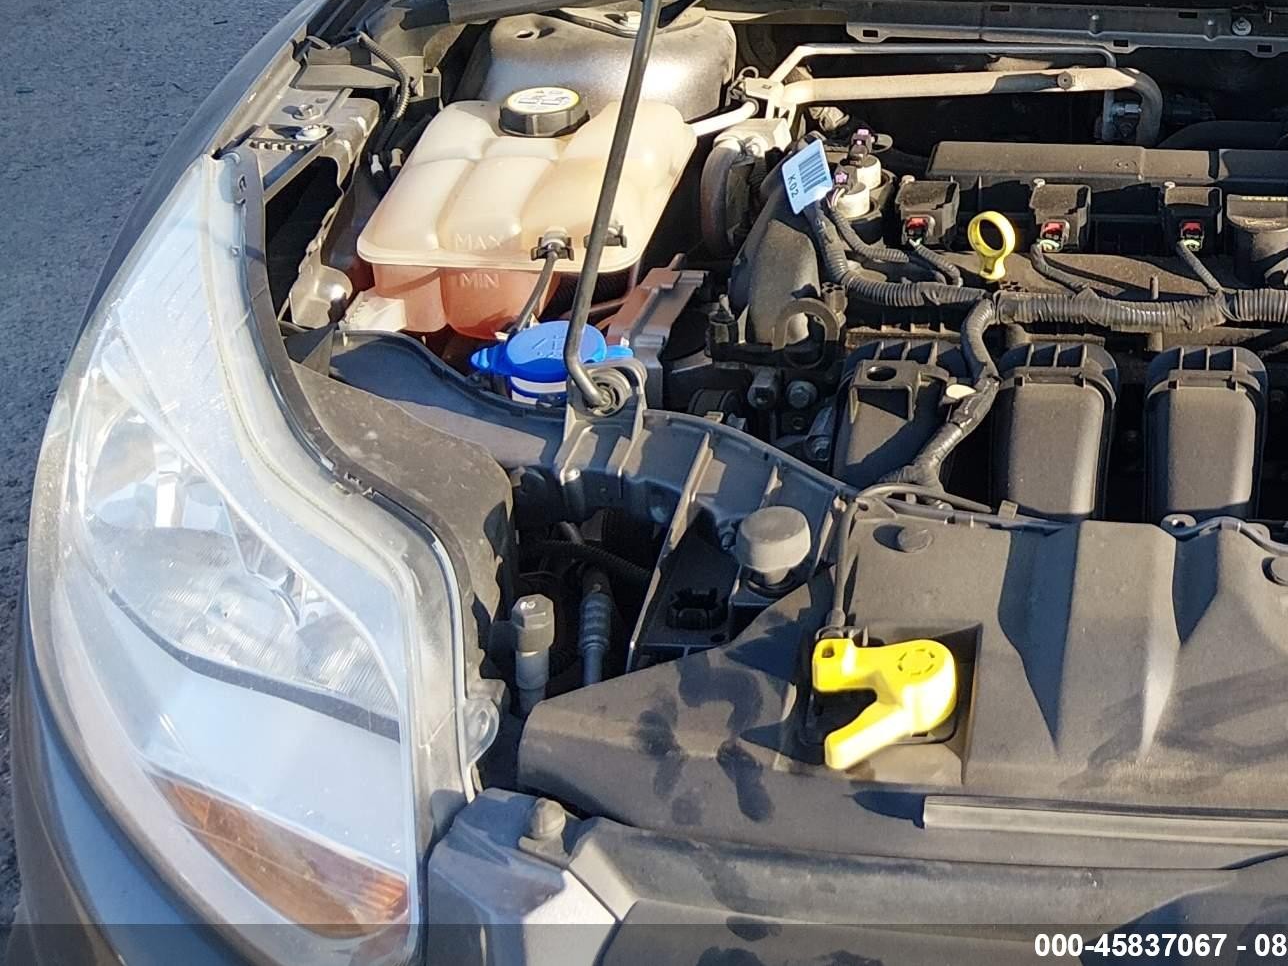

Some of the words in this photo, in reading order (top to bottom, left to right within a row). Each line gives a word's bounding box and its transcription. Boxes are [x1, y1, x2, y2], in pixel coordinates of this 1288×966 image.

[787, 173, 800, 199] K02
[455, 233, 501, 251] MAX
[459, 272, 500, 289] MIN
